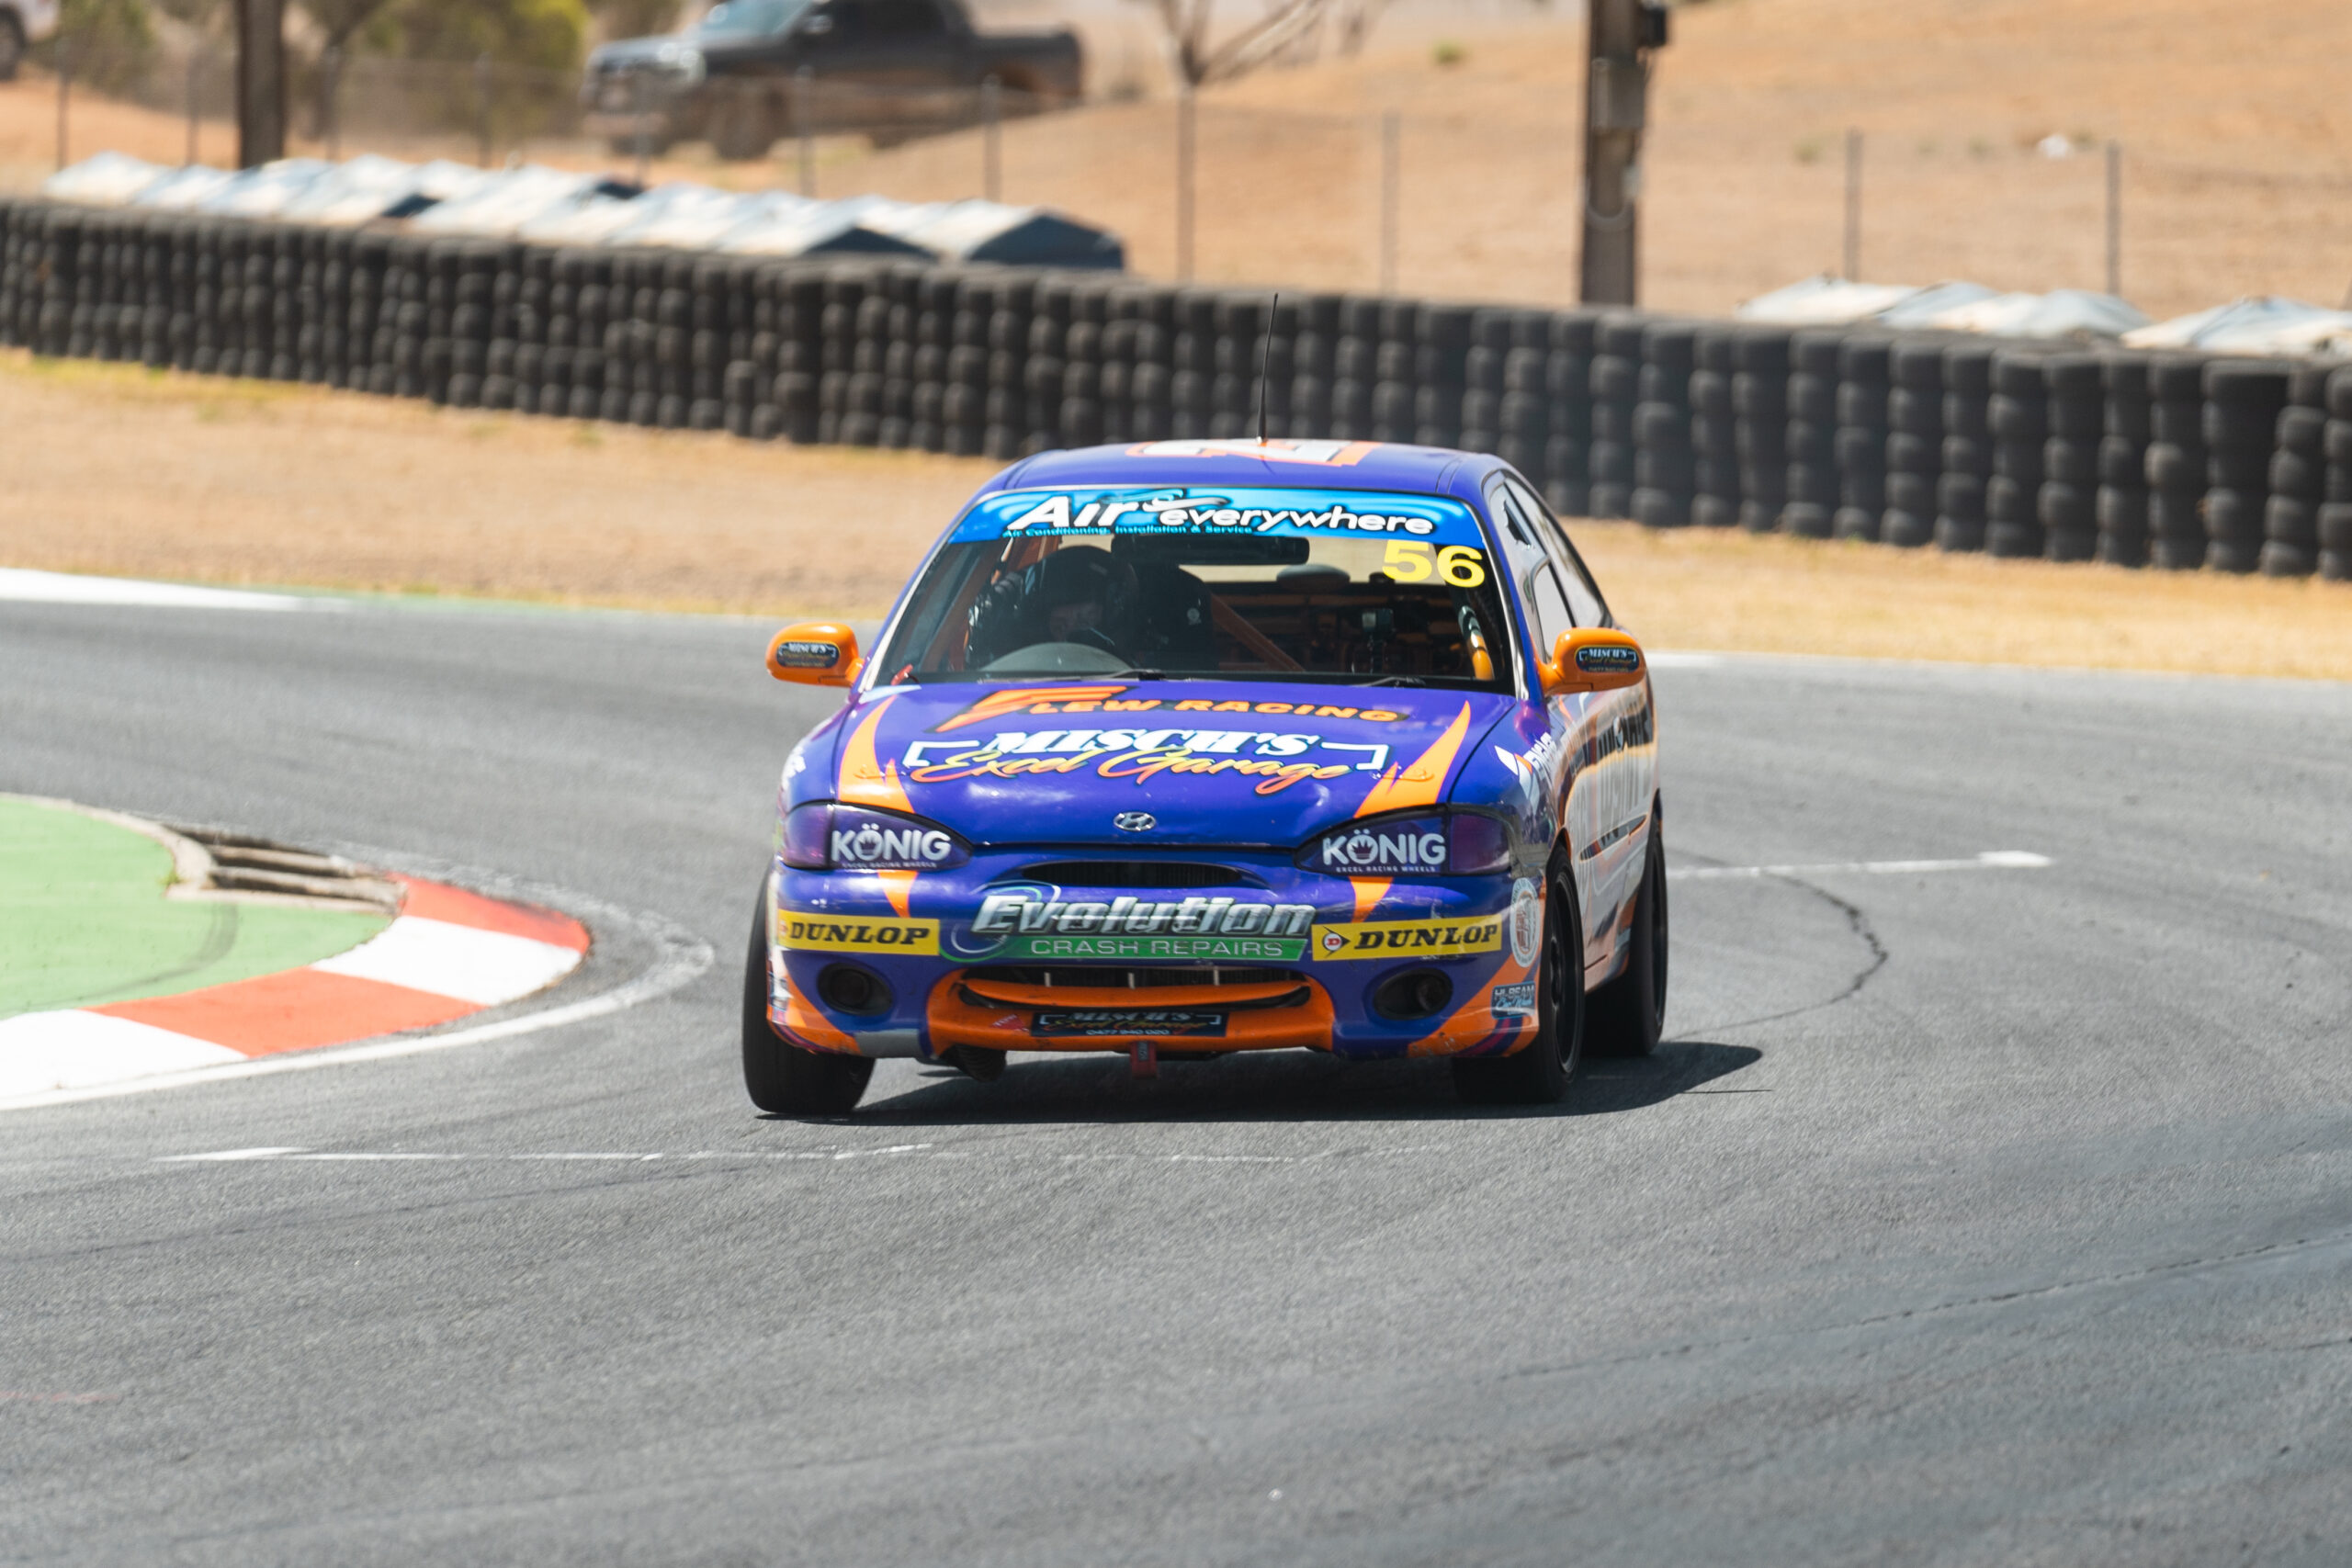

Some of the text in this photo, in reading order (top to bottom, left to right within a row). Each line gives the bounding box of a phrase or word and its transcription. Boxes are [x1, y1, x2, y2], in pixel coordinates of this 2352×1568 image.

[1006, 495, 1434, 535] Air everywhere
[1204, 525, 1253, 535] Service
[1382, 539, 1485, 588] 56
[1174, 699, 1398, 722] RACING
[979, 728, 1321, 756] MISCH'S
[910, 748, 1355, 795] Excel Garage
[831, 822, 952, 862] KÖNIG
[1322, 829, 1447, 865] KÖNIG
[970, 894, 1318, 936] Evolution
[790, 920, 931, 945] DUNLOP
[1030, 939, 1283, 957] CRASH REPAIRS
[1353, 923, 1498, 950] DUNLOP
